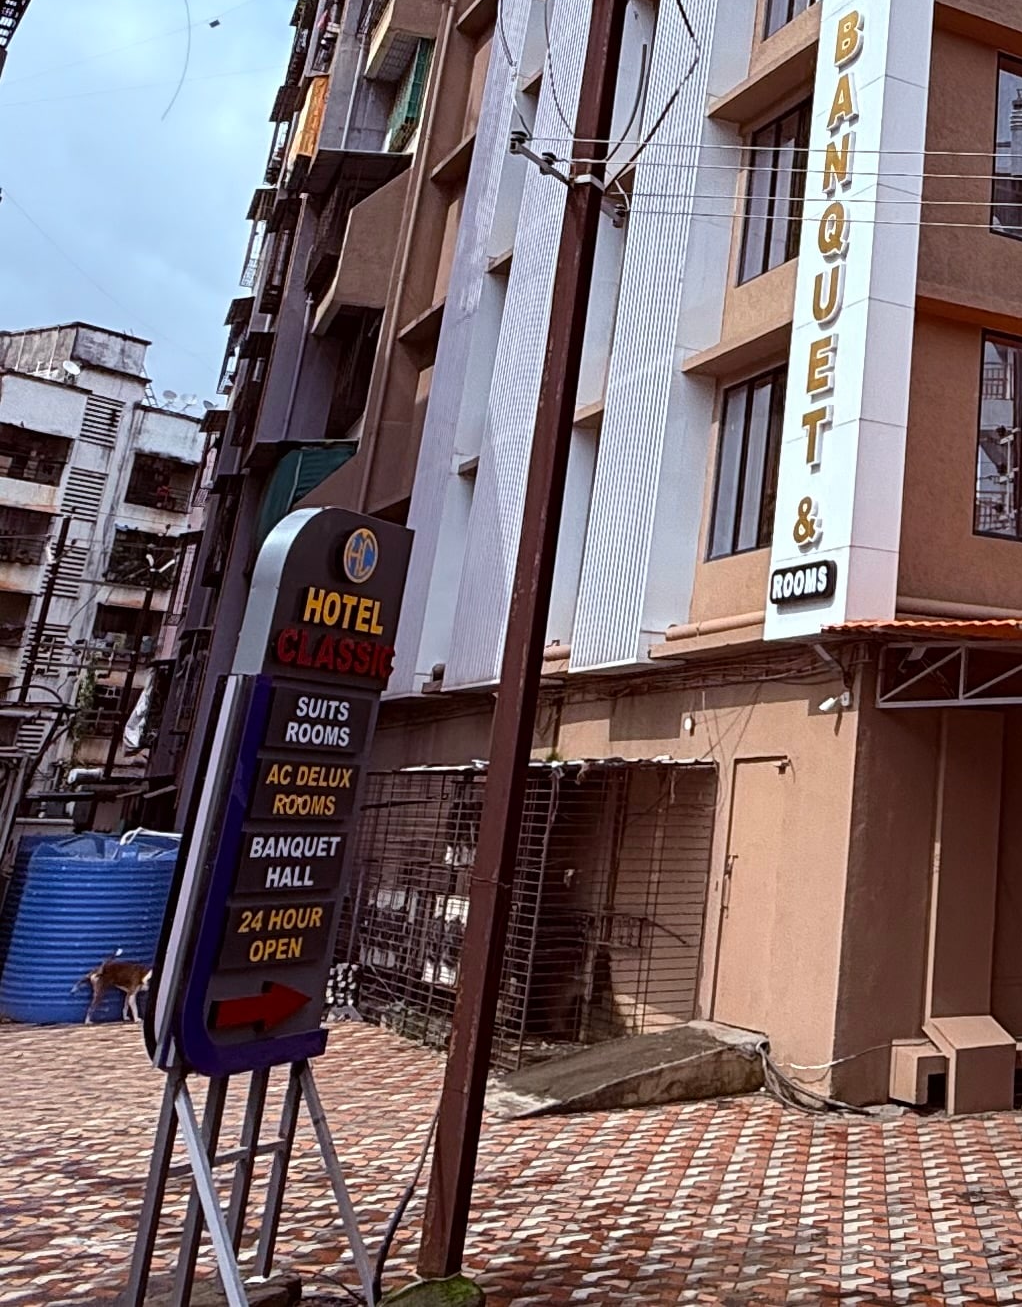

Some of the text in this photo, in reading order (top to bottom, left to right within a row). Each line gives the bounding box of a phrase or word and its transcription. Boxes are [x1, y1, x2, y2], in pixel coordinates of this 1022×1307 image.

[801, 10, 864, 474] BANQUET
[792, 496, 821, 549] &
[771, 565, 828, 601] ROOMS
[303, 586, 384, 635] HOTEL
[276, 628, 395, 679] CLASSIC
[296, 696, 350, 721] SUITS
[285, 721, 350, 747] ROOMS
[265, 764, 353, 788] AC DELUX
[272, 794, 336, 816] ROOMS
[249, 836, 341, 859] BANQUET
[265, 865, 314, 888] HALL
[237, 907, 323, 933] 24 HOUR
[249, 937, 303, 962] OPEN
